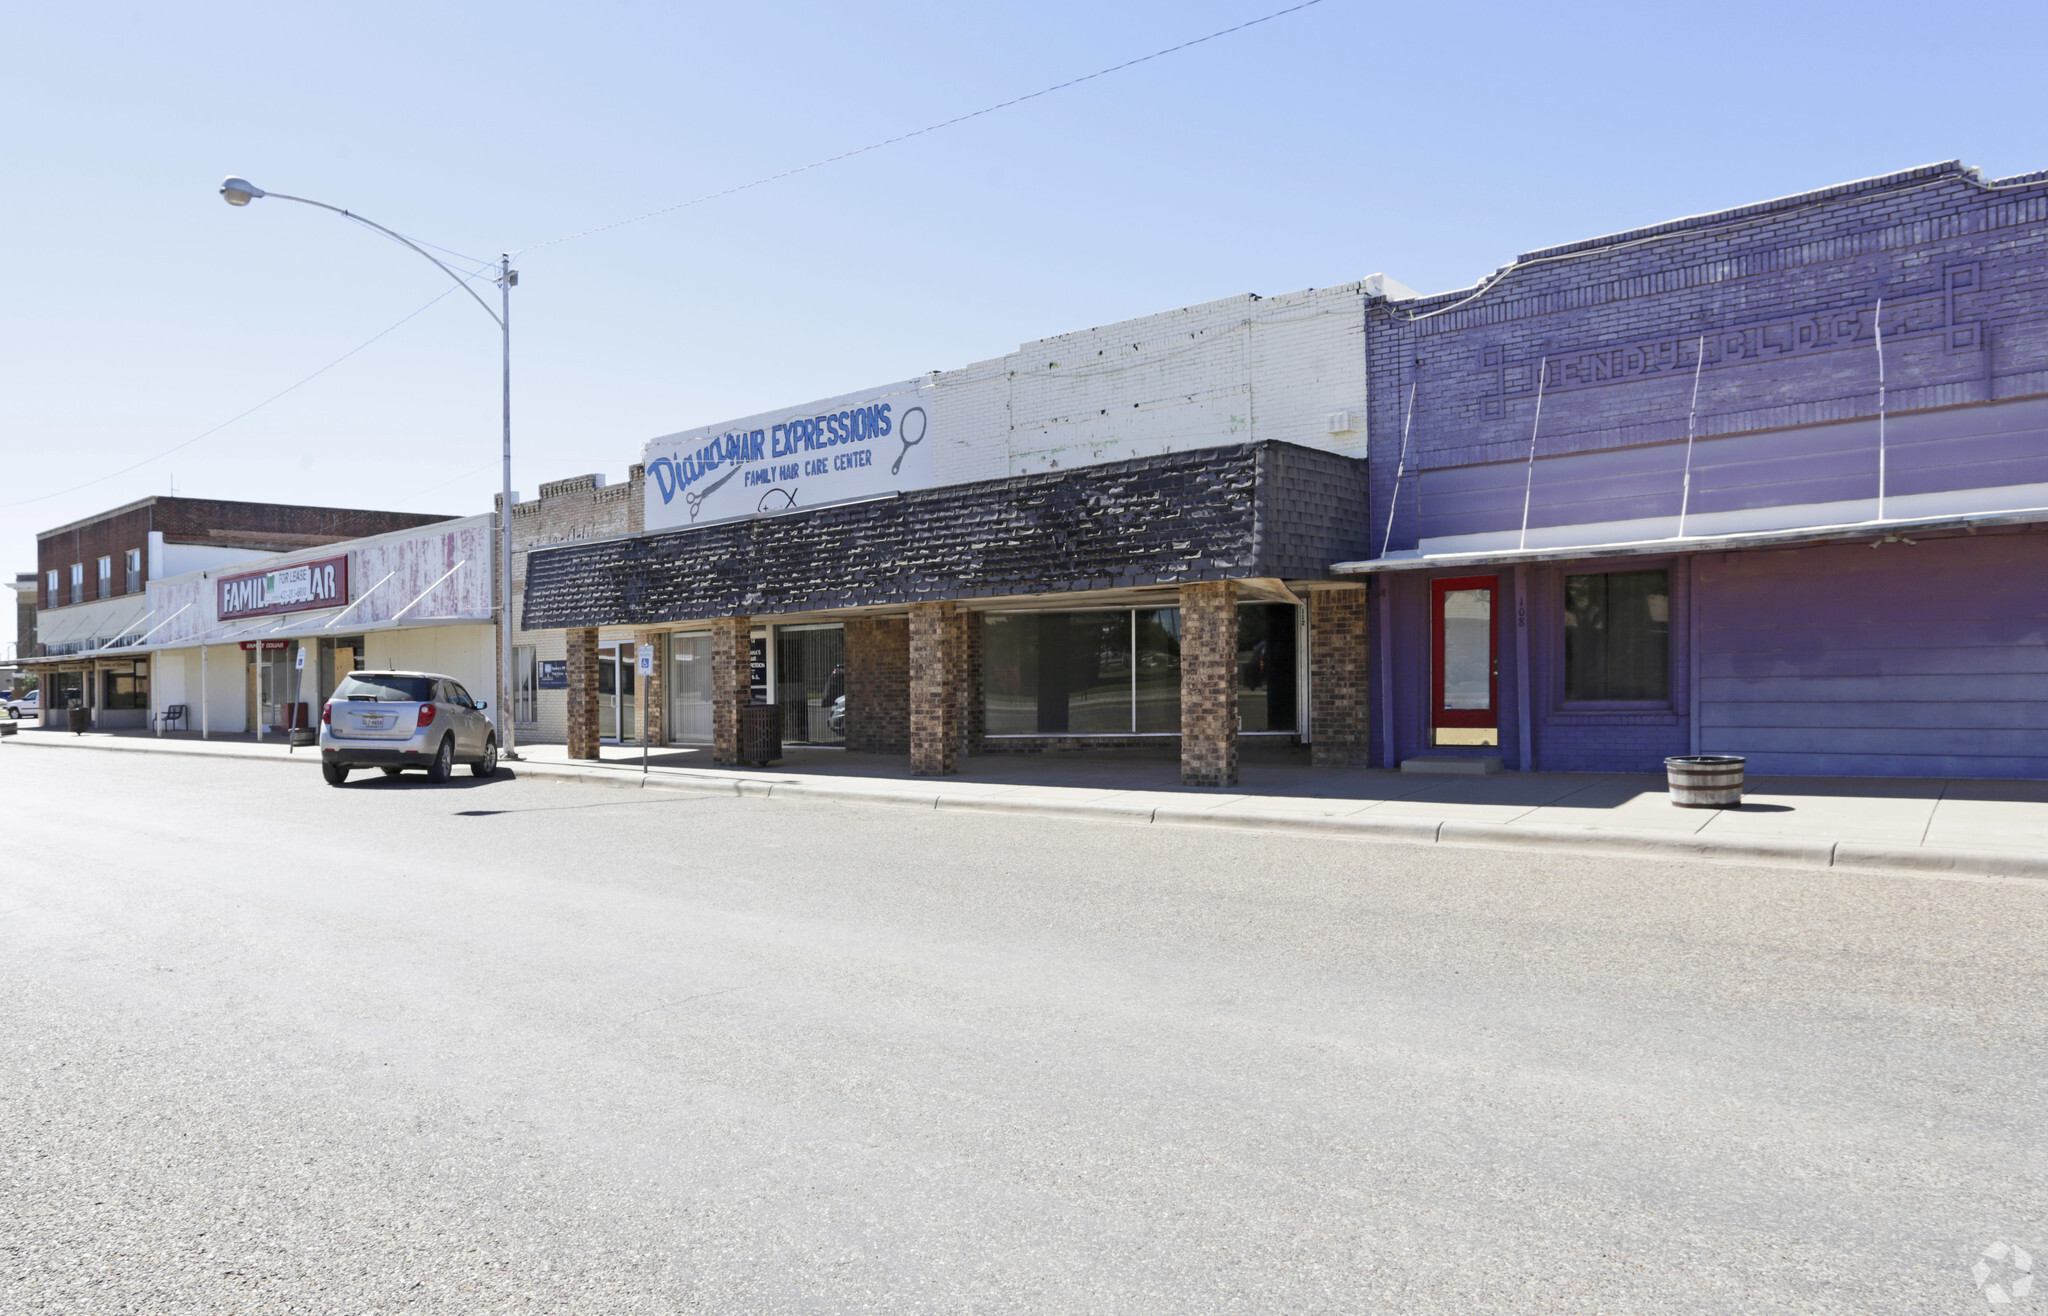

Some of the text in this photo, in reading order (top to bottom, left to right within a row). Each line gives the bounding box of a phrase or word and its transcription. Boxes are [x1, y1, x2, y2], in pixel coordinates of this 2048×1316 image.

[729, 429, 765, 466] HAIR
[771, 403, 892, 458] EXPRESSIONS
[744, 449, 872, 487] FAMILY HAIR CARE CENTER
[278, 568, 307, 585] FOR LEASE
